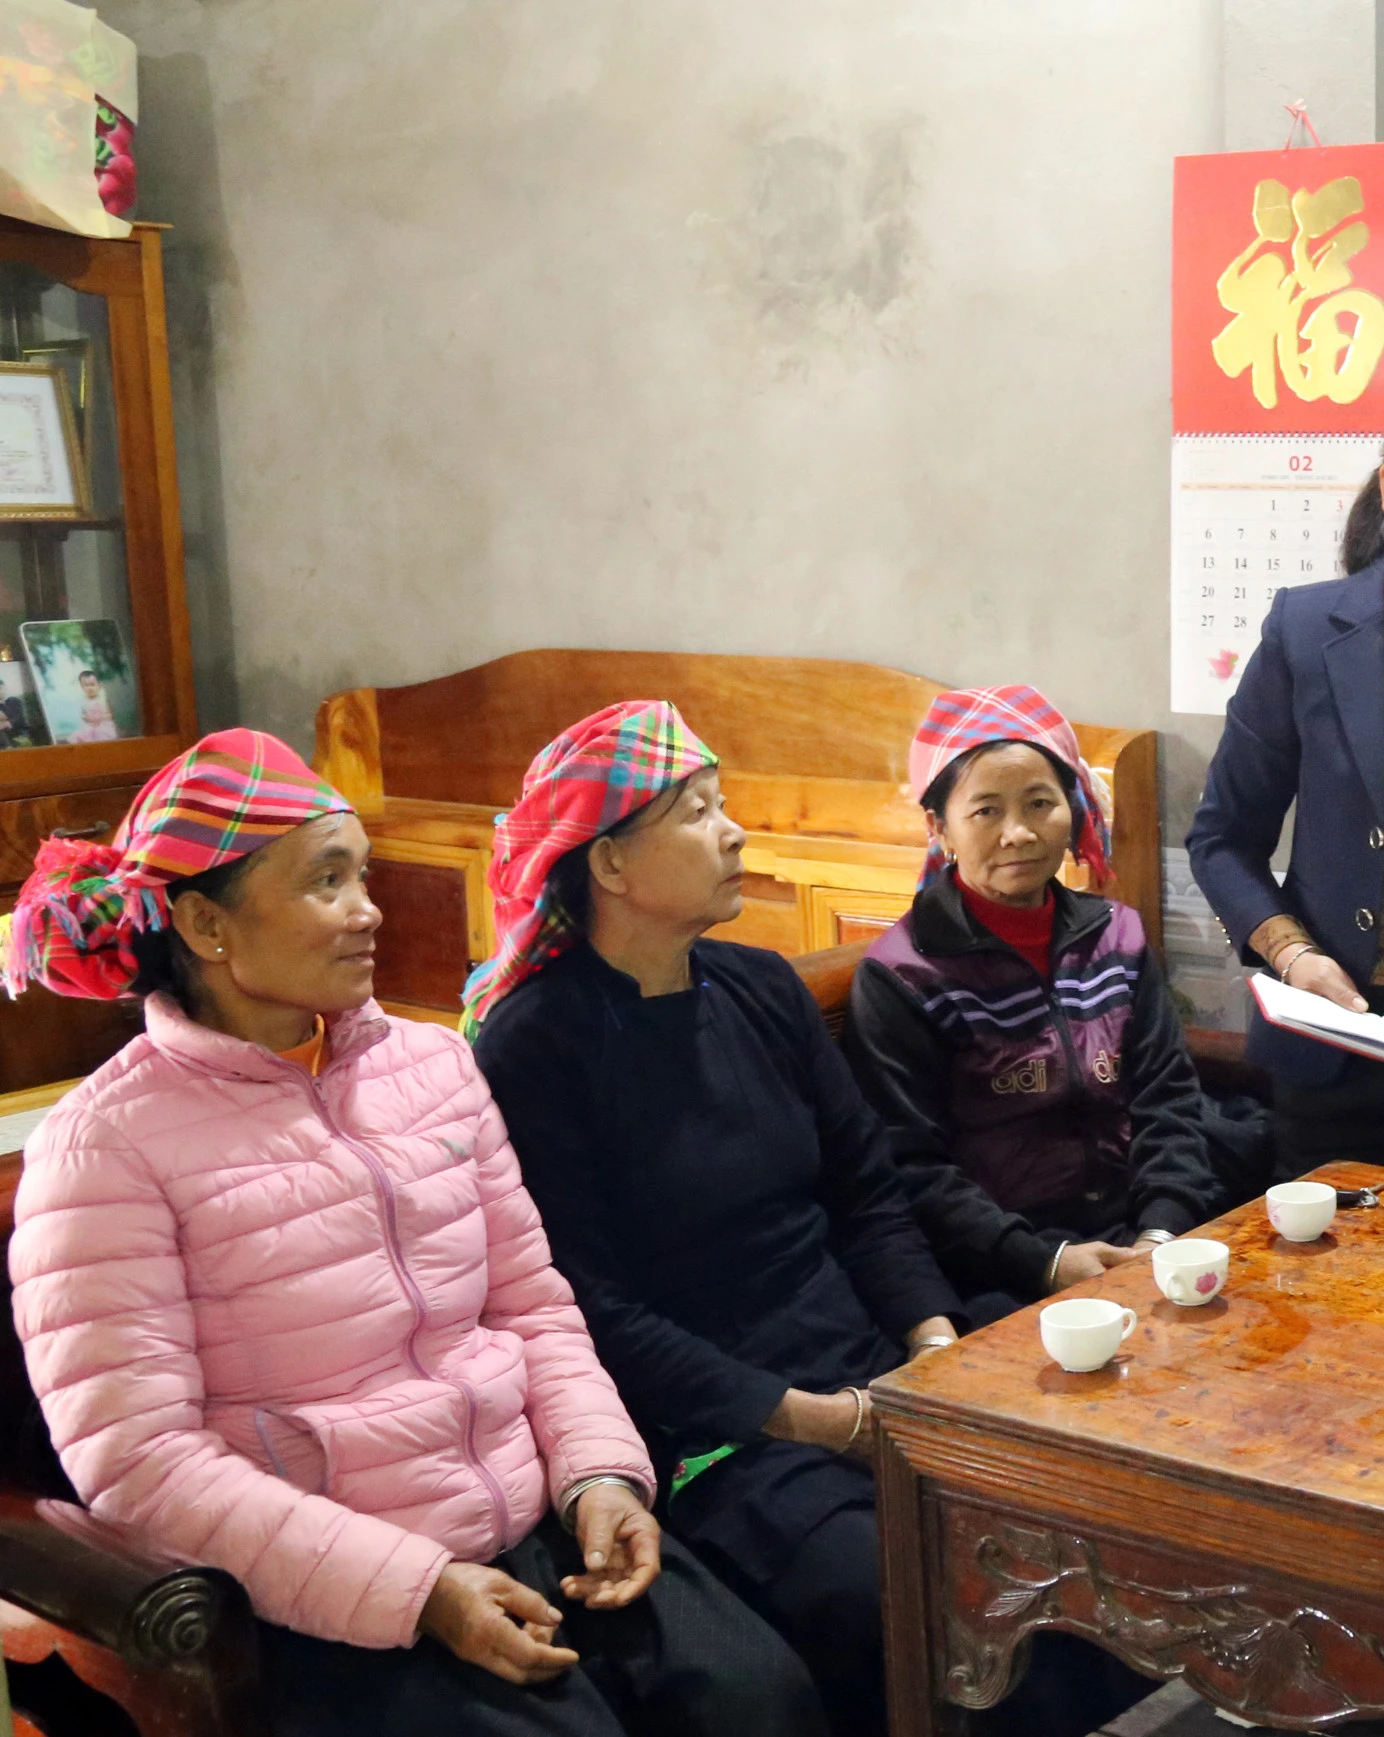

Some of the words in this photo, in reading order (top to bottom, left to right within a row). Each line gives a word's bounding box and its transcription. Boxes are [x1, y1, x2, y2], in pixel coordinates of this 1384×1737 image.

[1289, 456, 1313, 472] 02
[1304, 499, 1310, 511] 2
[1336, 499, 1343, 512] 3
[1205, 528, 1212, 540] 6
[1238, 528, 1244, 540] 7
[1270, 529, 1277, 541] 8
[1303, 529, 1310, 541] 9
[1202, 557, 1215, 569] 13
[1234, 558, 1247, 569] 14
[1267, 558, 1280, 570] 15
[1301, 559, 1313, 571] 16
[1201, 586, 1215, 598] 20
[1234, 587, 1246, 599] 21
[1266, 588, 1279, 600] 2
[1201, 615, 1214, 627] 27
[1234, 616, 1247, 628] 28
